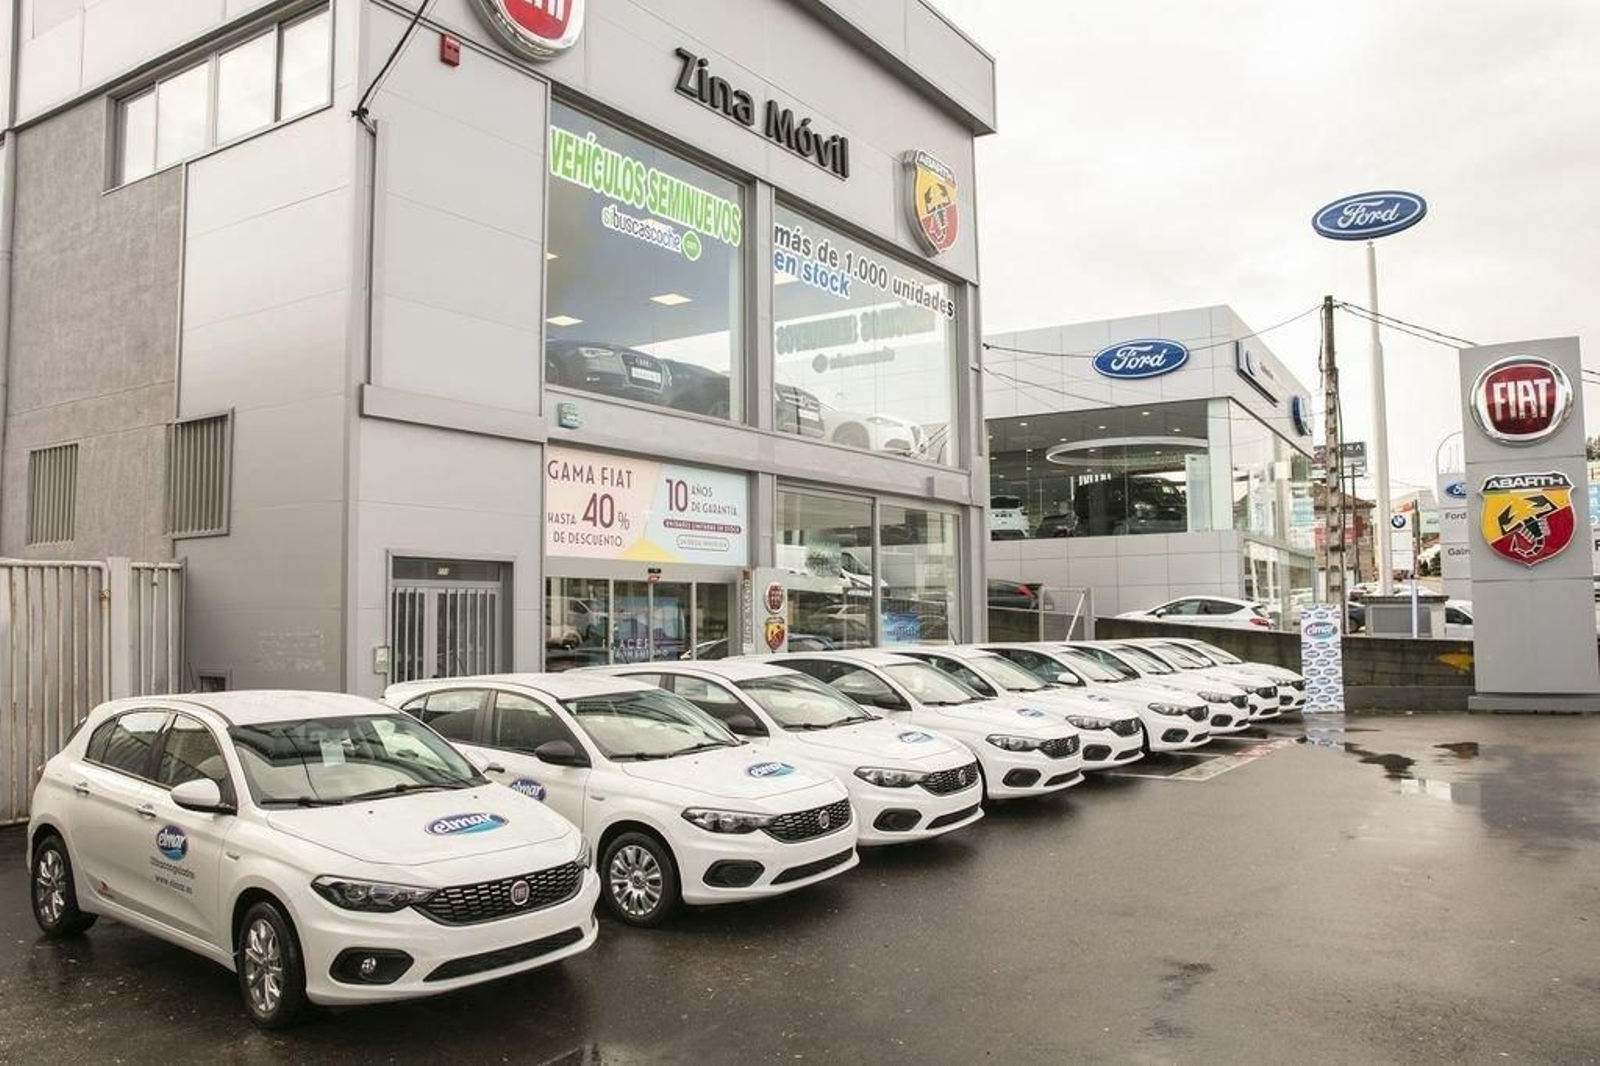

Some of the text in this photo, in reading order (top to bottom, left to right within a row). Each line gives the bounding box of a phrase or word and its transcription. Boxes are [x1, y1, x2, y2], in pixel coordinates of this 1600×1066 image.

[675, 47, 849, 178] Zina Móvil
[550, 131, 741, 246] VEHÍCULOS SEMINUEVOS
[1337, 200, 1400, 228] Ford
[774, 226, 956, 318] más de 1.000 unidades
[774, 252, 850, 297] en stock
[1110, 344, 1168, 371] Ford
[1492, 377, 1552, 421] FIAT
[547, 460, 633, 488] GAMA FIAT
[1487, 476, 1564, 490] ABARTH
[665, 478, 688, 513] 10
[691, 484, 713, 498] AÑOS
[547, 492, 631, 531] HASTA 40 %
[691, 501, 738, 516] DE GARANTÍA
[1444, 511, 1467, 520] Ford
[553, 530, 623, 548] DE DESCUENTO
[432, 812, 492, 834] elmar
[159, 828, 188, 849] elmar
